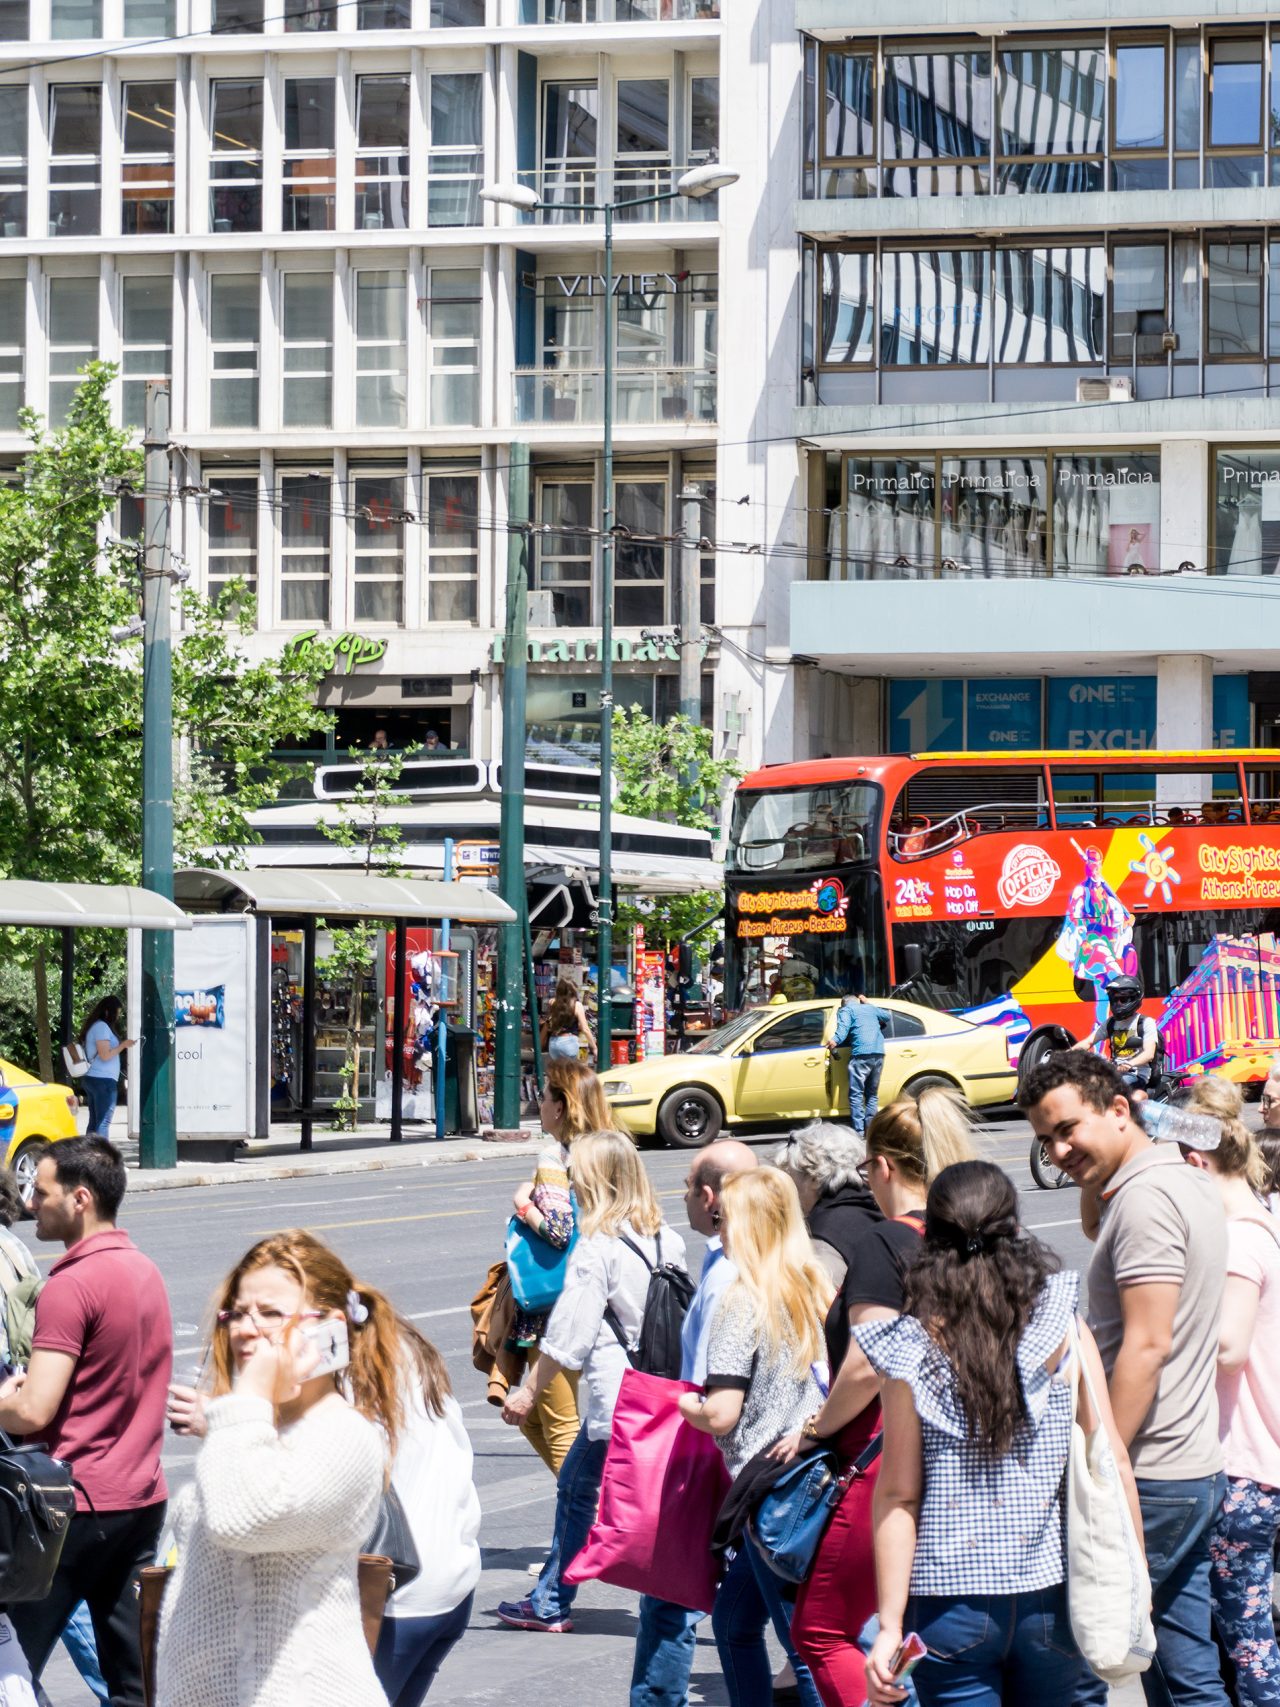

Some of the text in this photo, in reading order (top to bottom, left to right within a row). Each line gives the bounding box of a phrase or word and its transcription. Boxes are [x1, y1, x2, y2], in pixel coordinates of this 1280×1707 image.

[948, 469, 1041, 488] Primalicia
[1058, 467, 1153, 486] Primalicia
[976, 693, 1031, 702] EXCHANGE
[1069, 684, 1116, 703] ONE
[989, 731, 1018, 742] ONE
[1005, 861, 1059, 897] OFFICIAL
[1028, 879, 1050, 898] TOUR
[1201, 878, 1246, 899] Athens
[945, 884, 976, 899] Hop On
[738, 890, 818, 913] CitySightseeing
[947, 900, 979, 915] Hop Off
[738, 914, 846, 936] Athens Piraeus Beaches
[178, 1043, 203, 1060] cool
